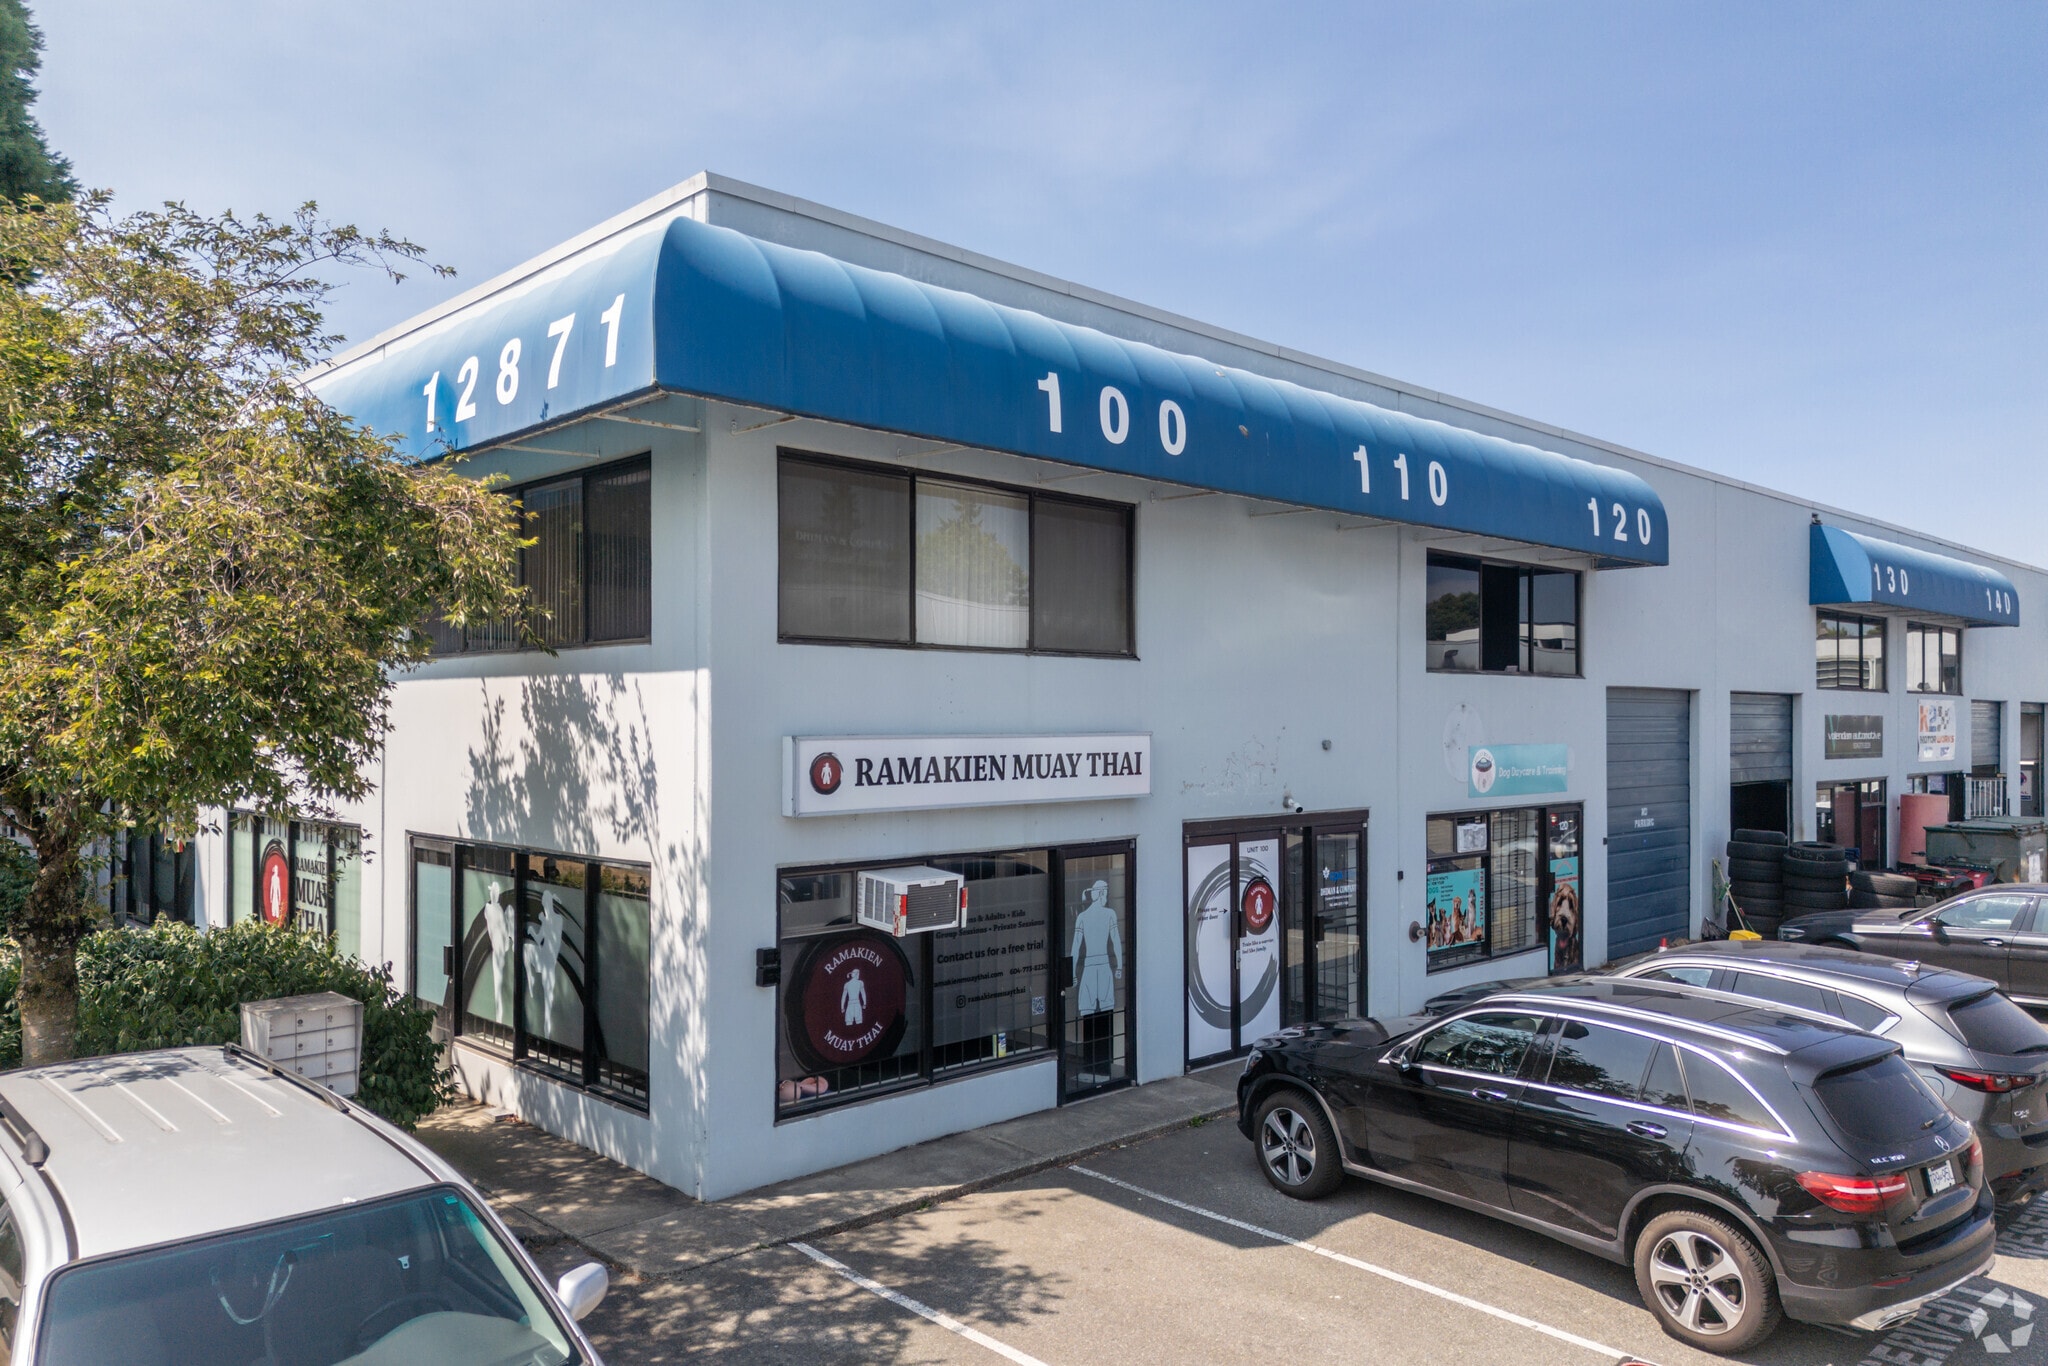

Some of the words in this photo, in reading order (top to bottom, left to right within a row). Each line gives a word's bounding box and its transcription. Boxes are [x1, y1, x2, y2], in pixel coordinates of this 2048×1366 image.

[423, 293, 625, 433] 12871
[1038, 371, 1188, 457] 100
[1353, 445, 1449, 507] 110
[1587, 497, 1652, 546] 120
[1873, 563, 1909, 596] 130
[1986, 588, 2011, 615] 140
[854, 754, 1006, 787] RAMAKIEN
[1012, 753, 1082, 781] MUAY
[1086, 751, 1143, 778] THAI
[1498, 767, 1510, 779] Dog
[295, 857, 327, 876] RAMAKIE
[985, 912, 1006, 921] Adults
[1011, 909, 1026, 918] Kids
[936, 931, 958, 940] Group
[959, 927, 988, 937] Sessions
[993, 923, 1017, 932] Private
[1018, 919, 1045, 928] Sessions
[824, 947, 883, 975] RAMAKIEN
[937, 951, 973, 964] Contact
[975, 950, 985, 958] us
[987, 946, 999, 957] for
[1001, 947, 1007, 955] a
[1008, 944, 1025, 953] free
[1026, 940, 1044, 950] trial
[934, 971, 1004, 988] amakienmuaythai.com
[823, 1029, 855, 1052] MUAY
[854, 1021, 884, 1049] THAI
